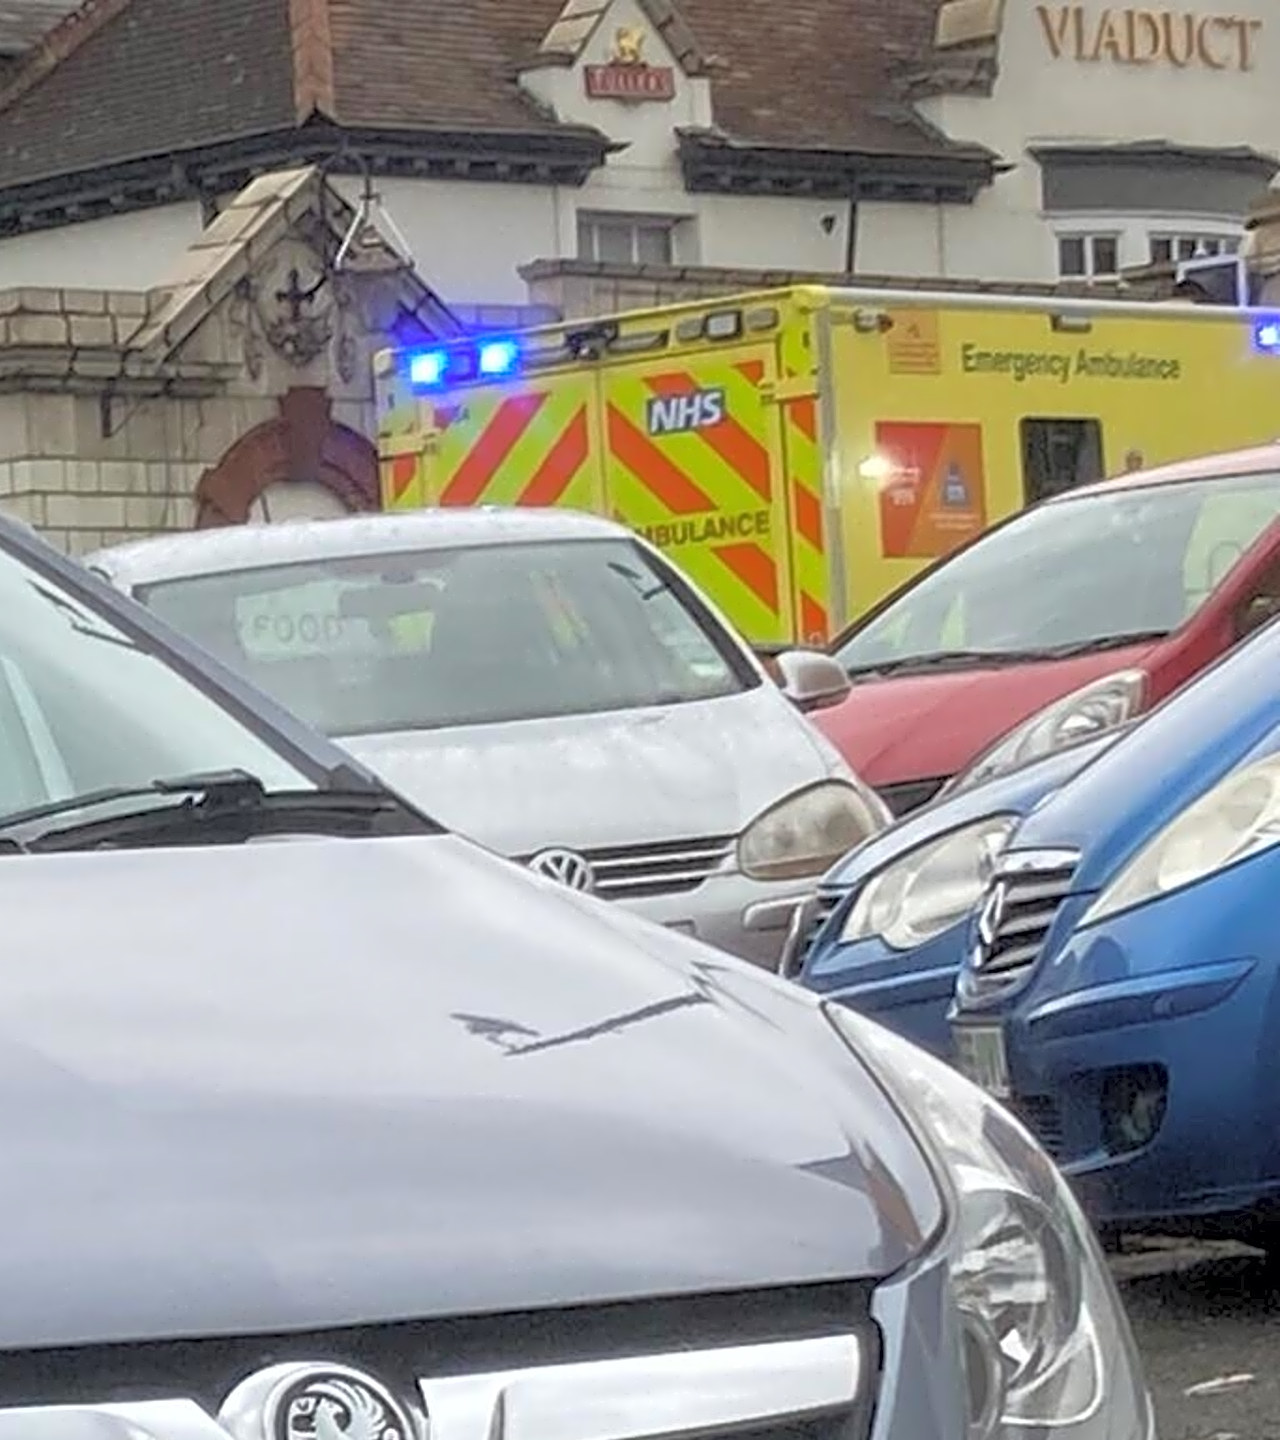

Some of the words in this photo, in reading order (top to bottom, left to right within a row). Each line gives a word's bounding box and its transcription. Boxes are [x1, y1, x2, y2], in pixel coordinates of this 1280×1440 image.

[1035, 5, 1263, 72] VIADUCT
[961, 343, 1071, 384] Emergency
[1075, 348, 1181, 380] Ambulance
[650, 390, 724, 434] NHS
[634, 508, 771, 548] MBULANCE
